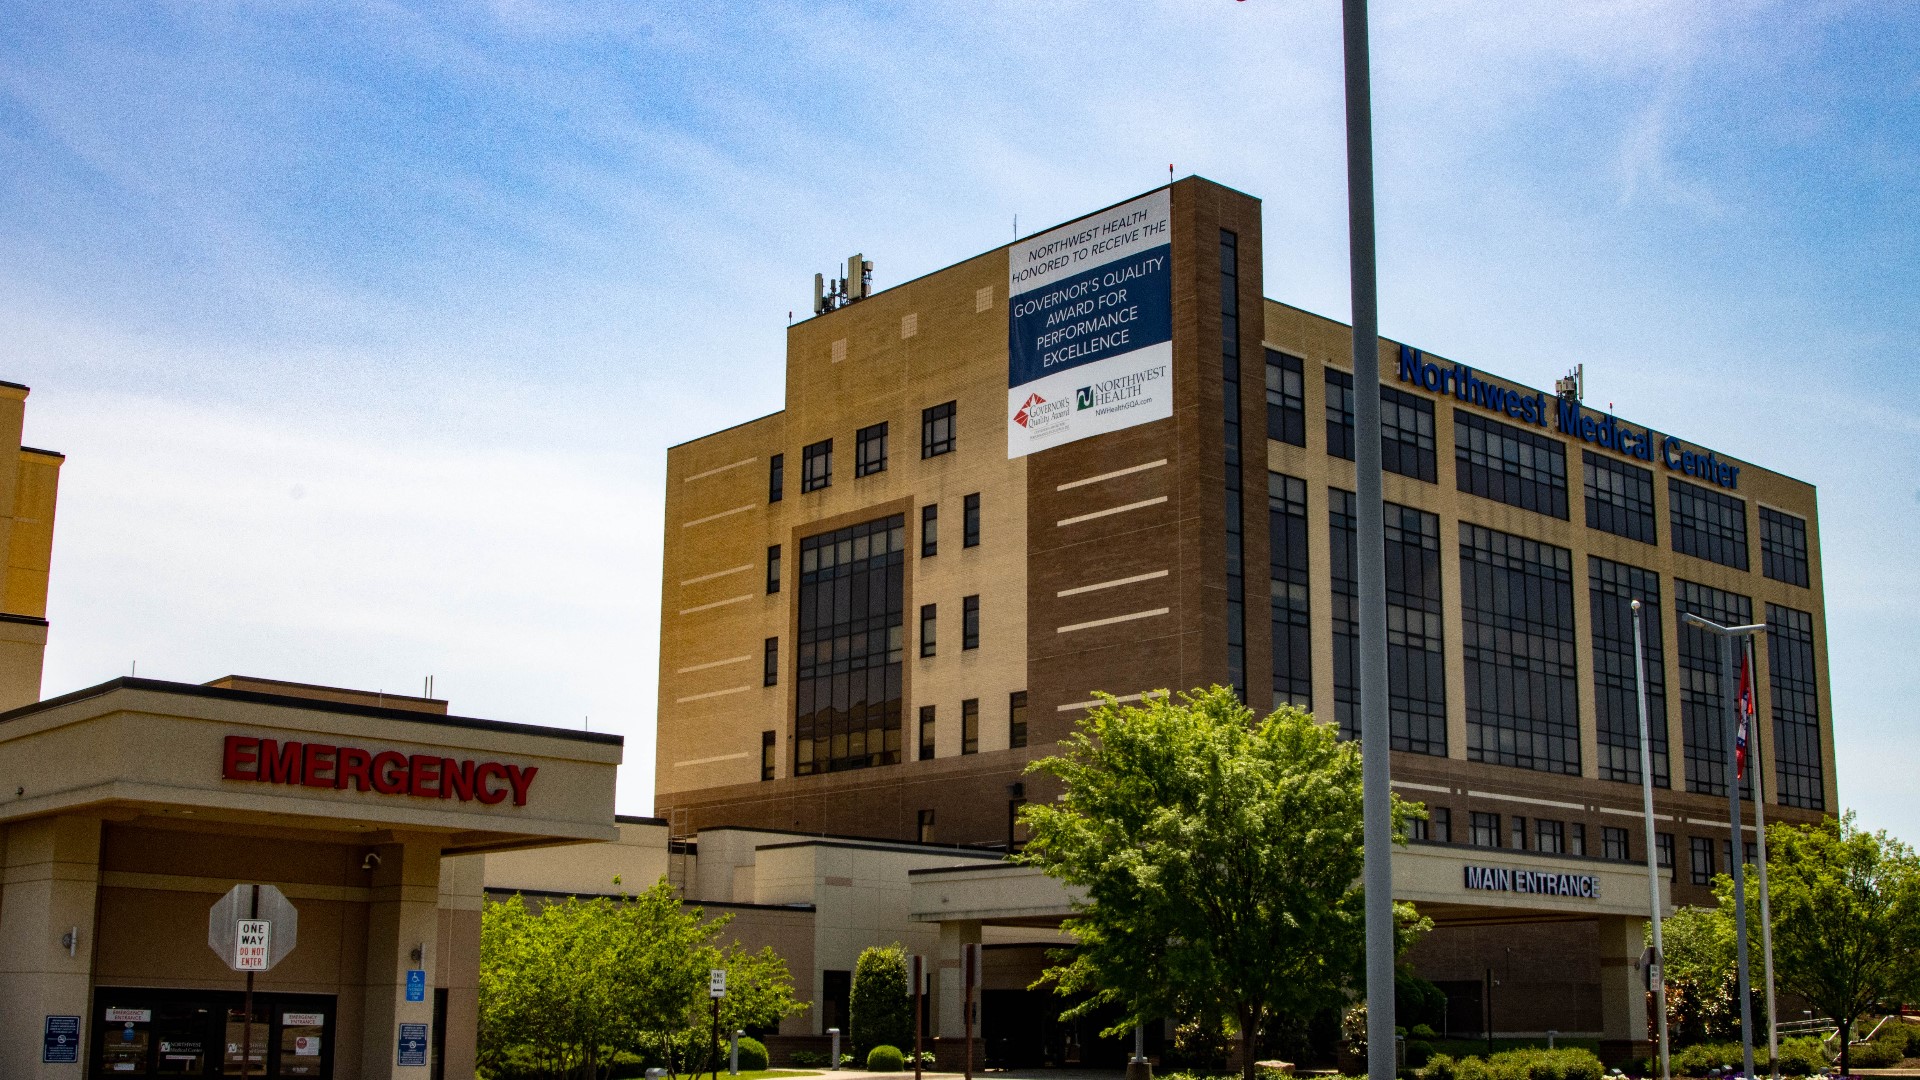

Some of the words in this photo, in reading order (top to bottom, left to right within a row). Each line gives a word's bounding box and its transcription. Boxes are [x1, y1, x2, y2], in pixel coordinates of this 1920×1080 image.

[1012, 255, 1070, 284] HONORED
[1072, 248, 1088, 263] TO
[1091, 229, 1139, 256] RECEIVE
[1143, 219, 1167, 237] THE
[1028, 226, 1100, 262] NORTHWEST
[1102, 209, 1148, 235] HEALTH
[1014, 277, 1099, 318] GOVERNOR'S
[1103, 256, 1164, 287] QUALITY
[1046, 300, 1094, 328] AWARD
[1098, 289, 1127, 310] FOR
[1037, 306, 1138, 350] PERFORMANCE
[1043, 329, 1130, 368] EXCELLENCE
[1095, 365, 1166, 394] NORTHWEST
[1095, 383, 1141, 406] HEALTH
[1029, 415, 1050, 429] Quality
[1051, 407, 1070, 421] Award
[1095, 397, 1153, 416] NWHealthGQA.com
[1400, 344, 1547, 428] Northwest
[1556, 398, 1654, 462] Medical
[1663, 436, 1741, 489] Center
[222, 735, 539, 807] EMERGENCY
[1464, 866, 1510, 891] MAIN
[1512, 870, 1601, 899] ENTRANCE
[242, 935, 264, 945] WAY
[243, 923, 264, 934] ONE
[240, 947, 249, 956] DO
[251, 947, 265, 956] NOT
[241, 957, 262, 966] ENTER
